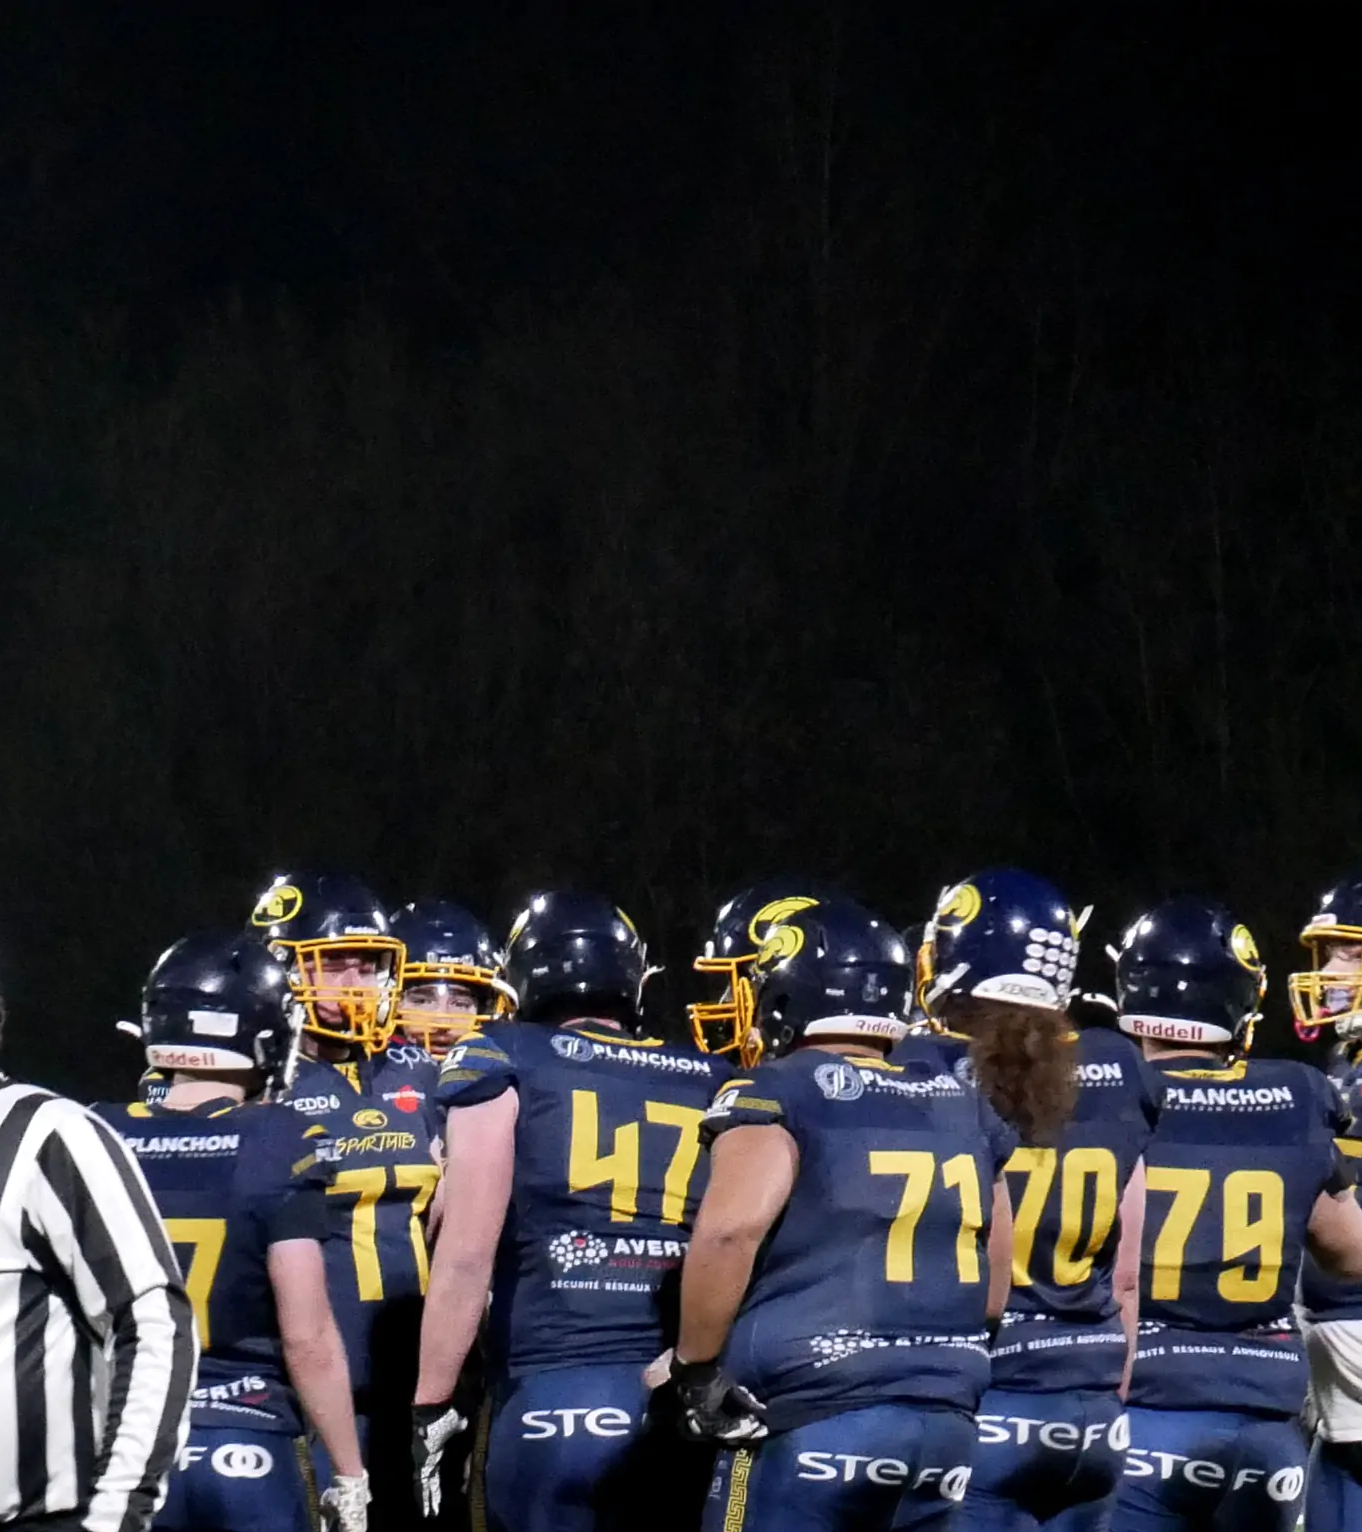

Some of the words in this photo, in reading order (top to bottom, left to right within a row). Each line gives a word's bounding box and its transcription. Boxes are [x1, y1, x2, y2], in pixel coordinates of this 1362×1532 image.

[592, 1044, 711, 1074] PLANCHON
[1133, 1020, 1204, 1041] Riddell
[1166, 1086, 1293, 1106] PLANCHON
[125, 1134, 240, 1153] PLANCHON
[569, 1090, 706, 1225] 47
[325, 1164, 440, 1301] 77
[869, 1150, 990, 1284] 71
[1002, 1147, 1118, 1287] 70
[1143, 1166, 1286, 1303] 79
